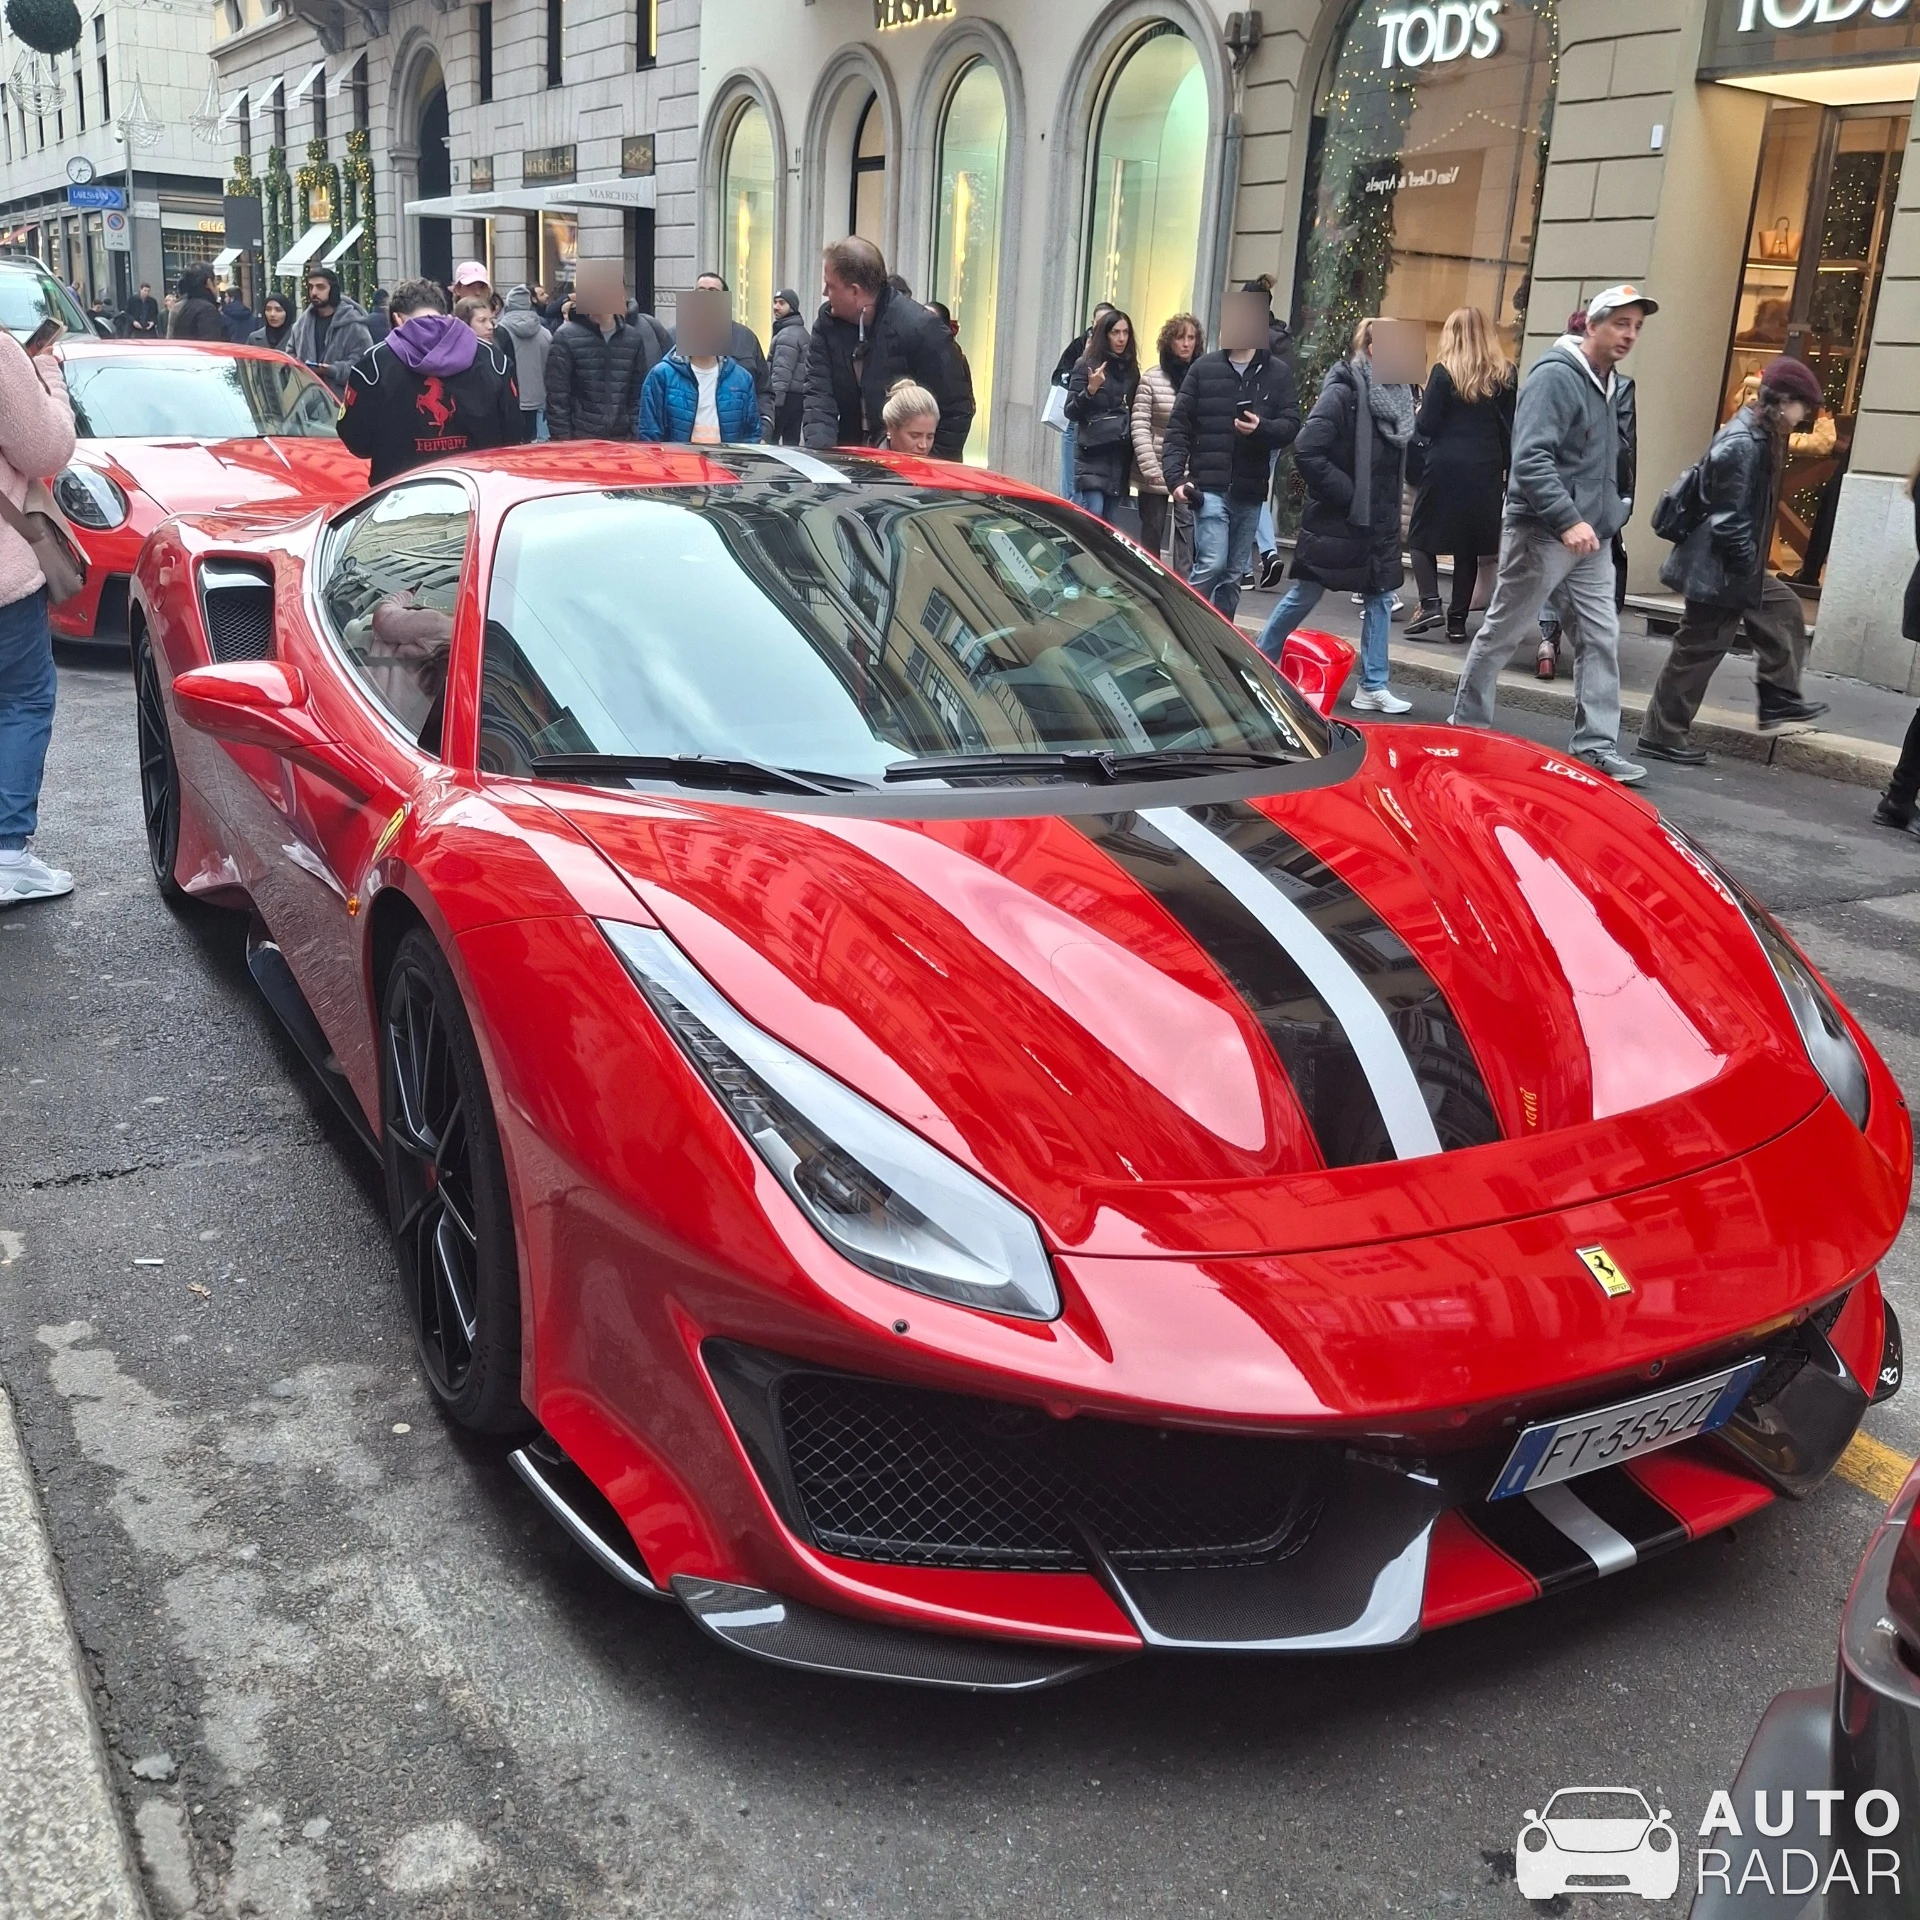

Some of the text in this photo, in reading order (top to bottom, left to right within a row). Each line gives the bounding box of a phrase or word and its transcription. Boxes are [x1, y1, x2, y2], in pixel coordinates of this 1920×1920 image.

[1377, 0, 1501, 69] TOD'S
[524, 155, 575, 176] MARCHESI
[588, 187, 640, 202] MARCHESI
[414, 436, 468, 451] Ferrari
